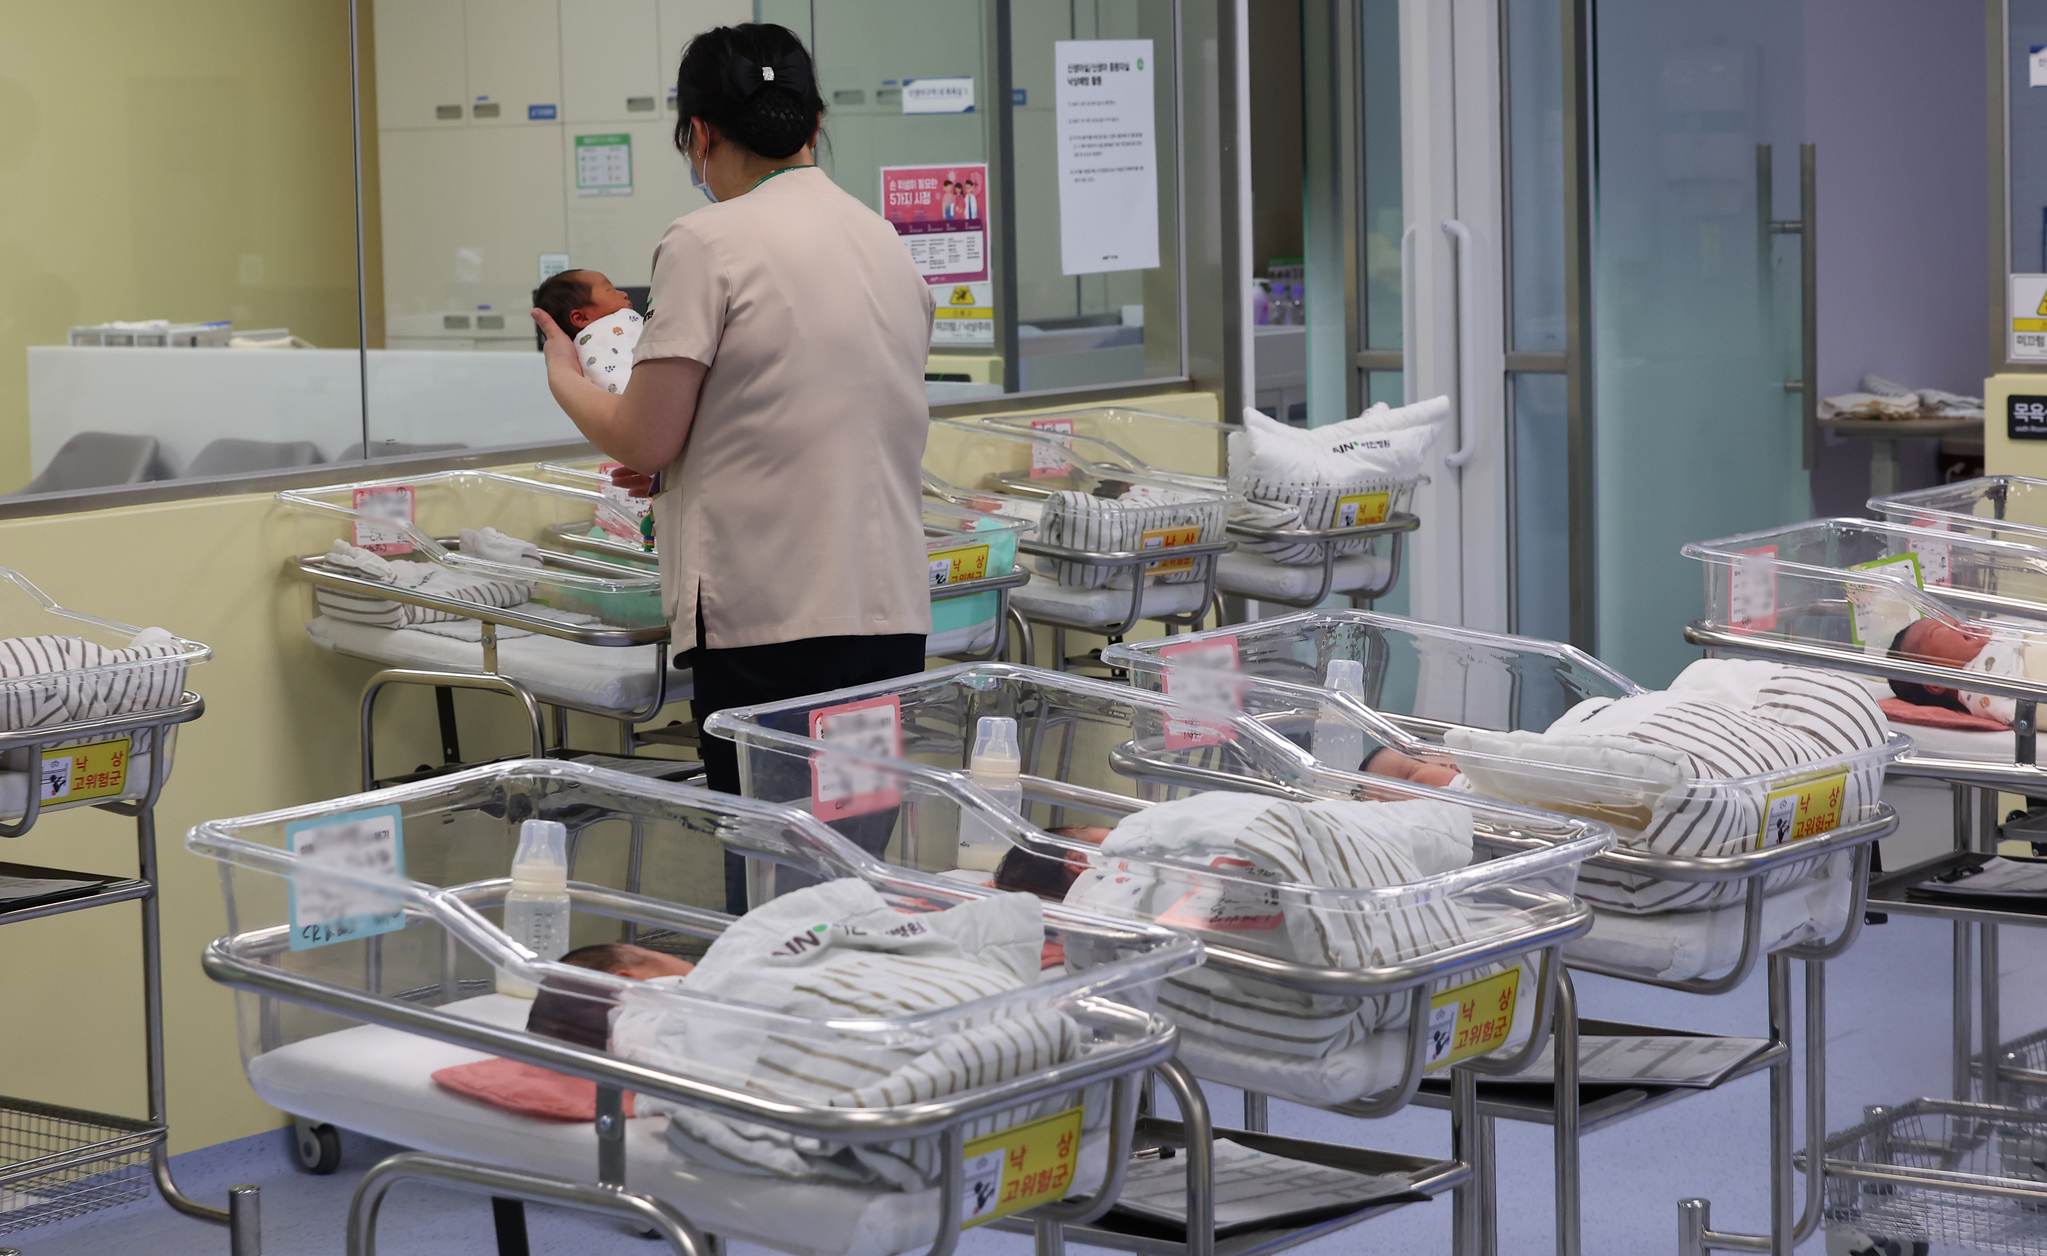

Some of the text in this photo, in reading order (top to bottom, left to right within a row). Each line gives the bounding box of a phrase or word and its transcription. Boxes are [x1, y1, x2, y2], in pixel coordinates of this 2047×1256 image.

[889, 180, 897, 191] 손
[889, 191, 931, 205] 5가지 시점
[76, 751, 124, 772] 낙 상
[72, 771, 122, 791] 고위험군
[1800, 786, 1840, 814] 낙 상
[1462, 986, 1512, 1022] 낙 상
[1454, 1015, 1508, 1051] 고위험군
[1010, 1130, 1073, 1172] 낙 상
[1001, 1163, 1068, 1203] 고위험군
